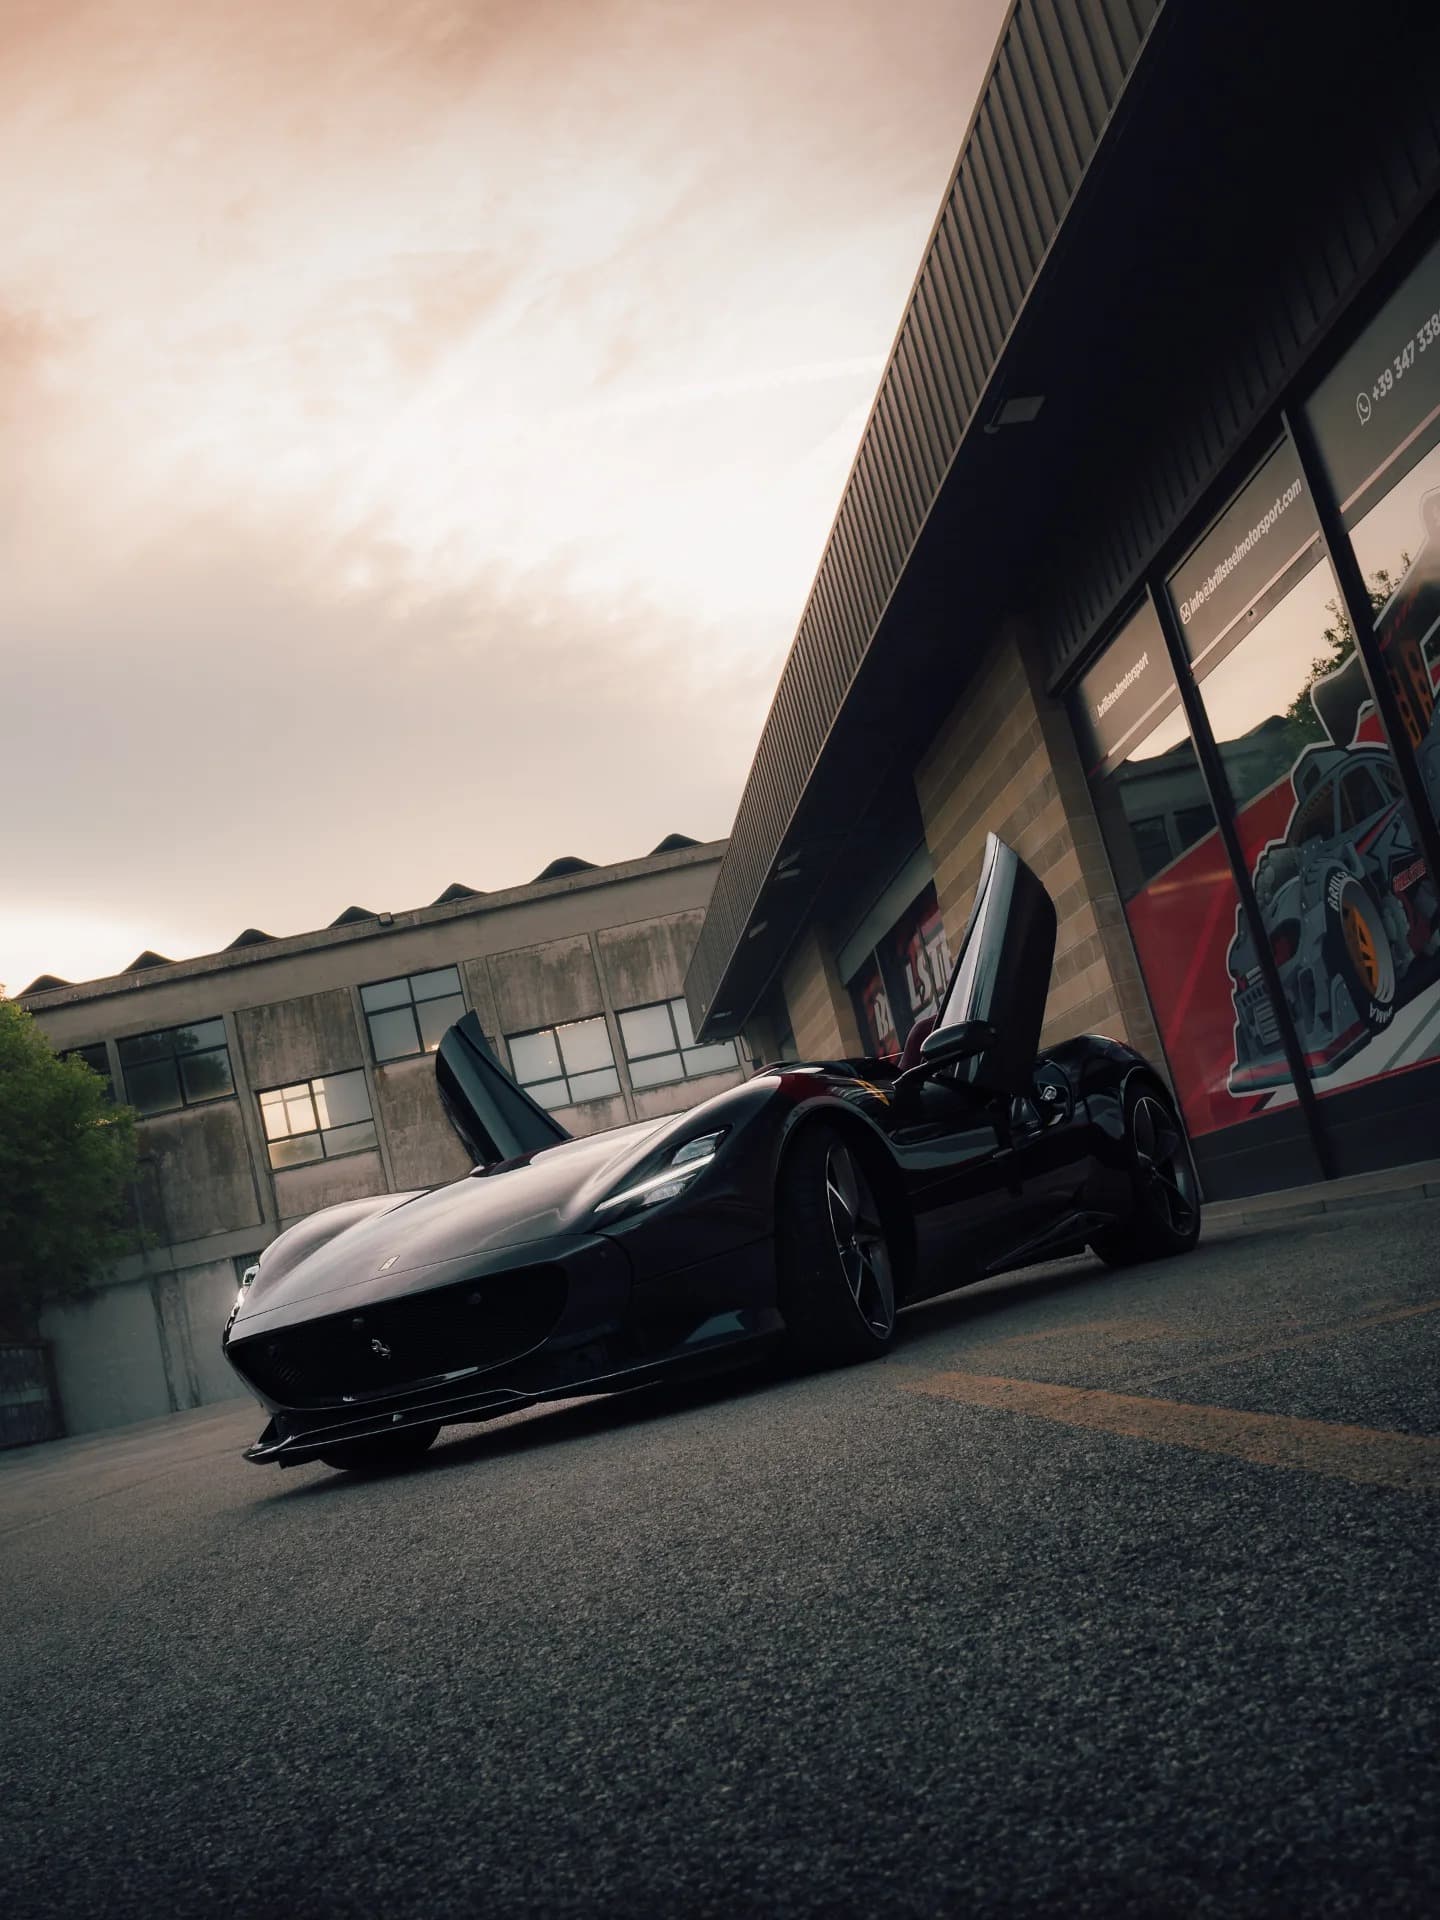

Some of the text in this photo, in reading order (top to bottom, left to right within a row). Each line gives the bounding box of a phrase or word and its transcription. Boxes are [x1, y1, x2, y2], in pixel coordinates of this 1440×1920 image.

[1373, 310, 1440, 401] +39 347 338
[1189, 478, 1302, 615] info@brillsteelmotorsport.com
[1097, 651, 1149, 718] brillsteelmotorsport
